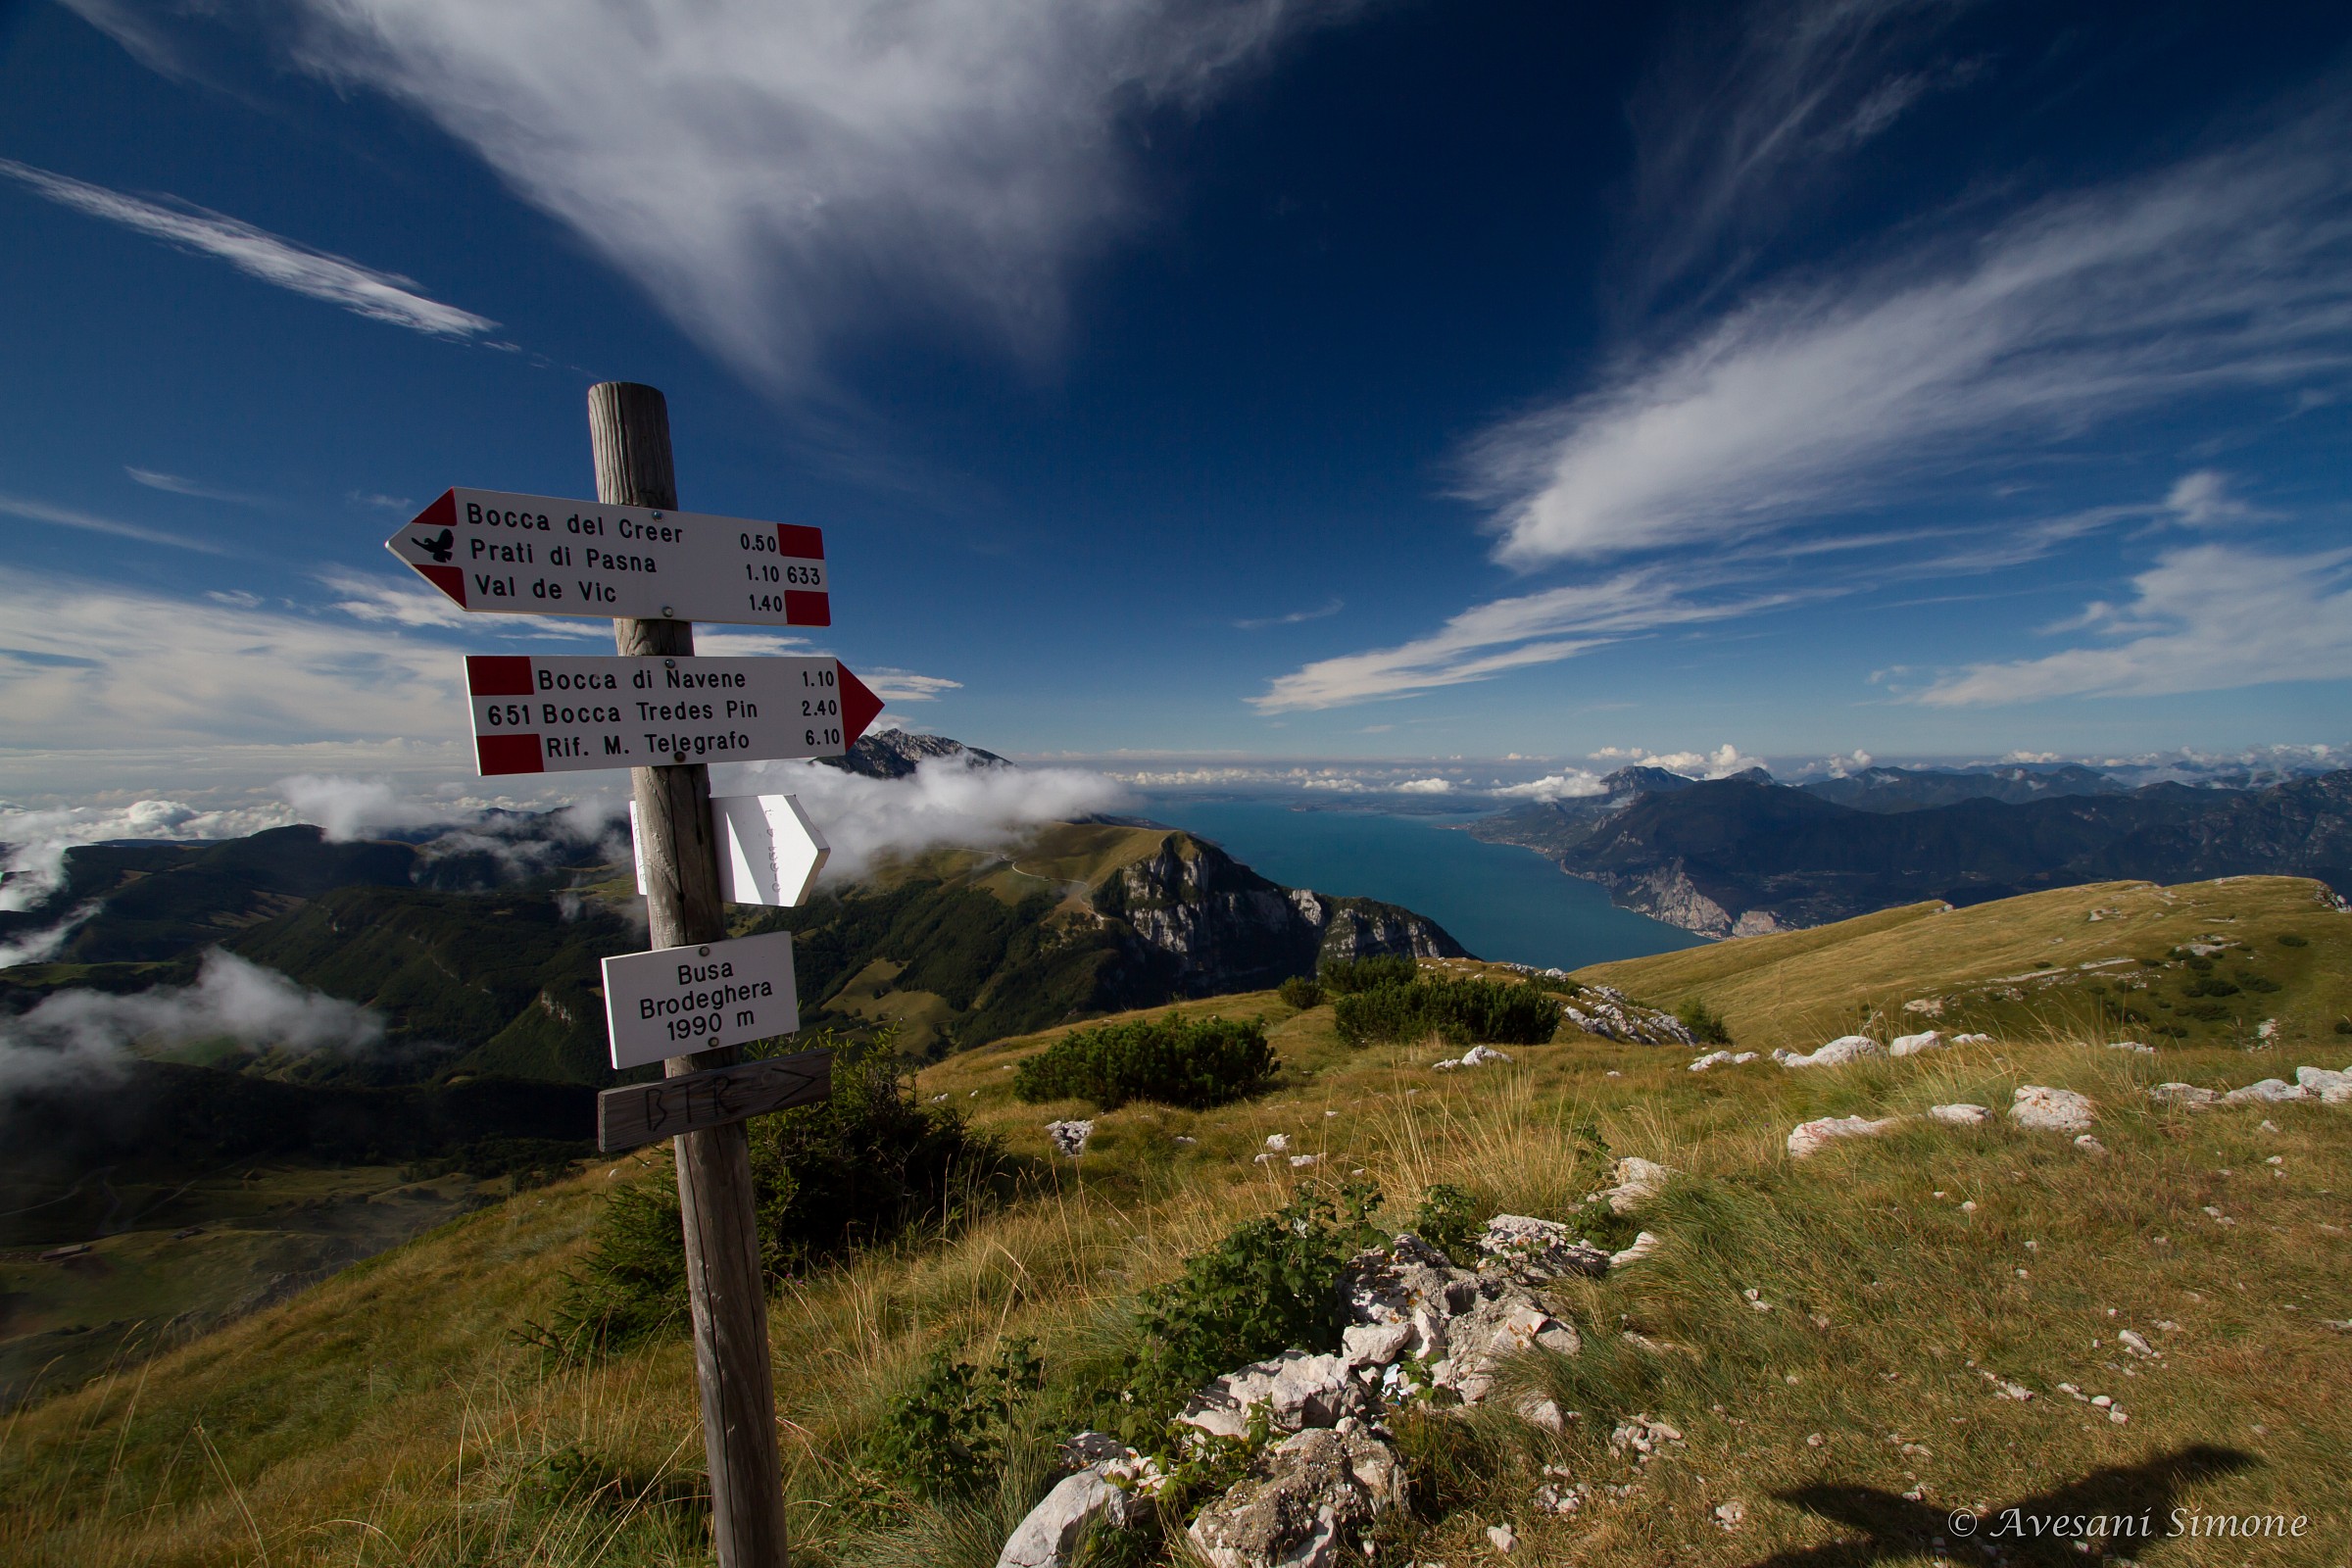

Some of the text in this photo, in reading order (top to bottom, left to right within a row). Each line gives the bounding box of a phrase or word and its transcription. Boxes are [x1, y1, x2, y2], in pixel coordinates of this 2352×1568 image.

[466, 503, 776, 552] Bocca del Creer 0.50
[471, 539, 820, 585] Prati di Pasna 1.10 633
[475, 575, 782, 612] Val de Vic 1.40
[539, 670, 834, 690] Bocca di Navene 1.10
[488, 700, 837, 725] 651 Bocca Tredes Pin 2.40
[547, 730, 840, 757] Rif. M. Telegrafo 6.10
[677, 961, 733, 985] Busa
[640, 982, 772, 1019] Brodeghera
[667, 1011, 755, 1041] 1990 m
